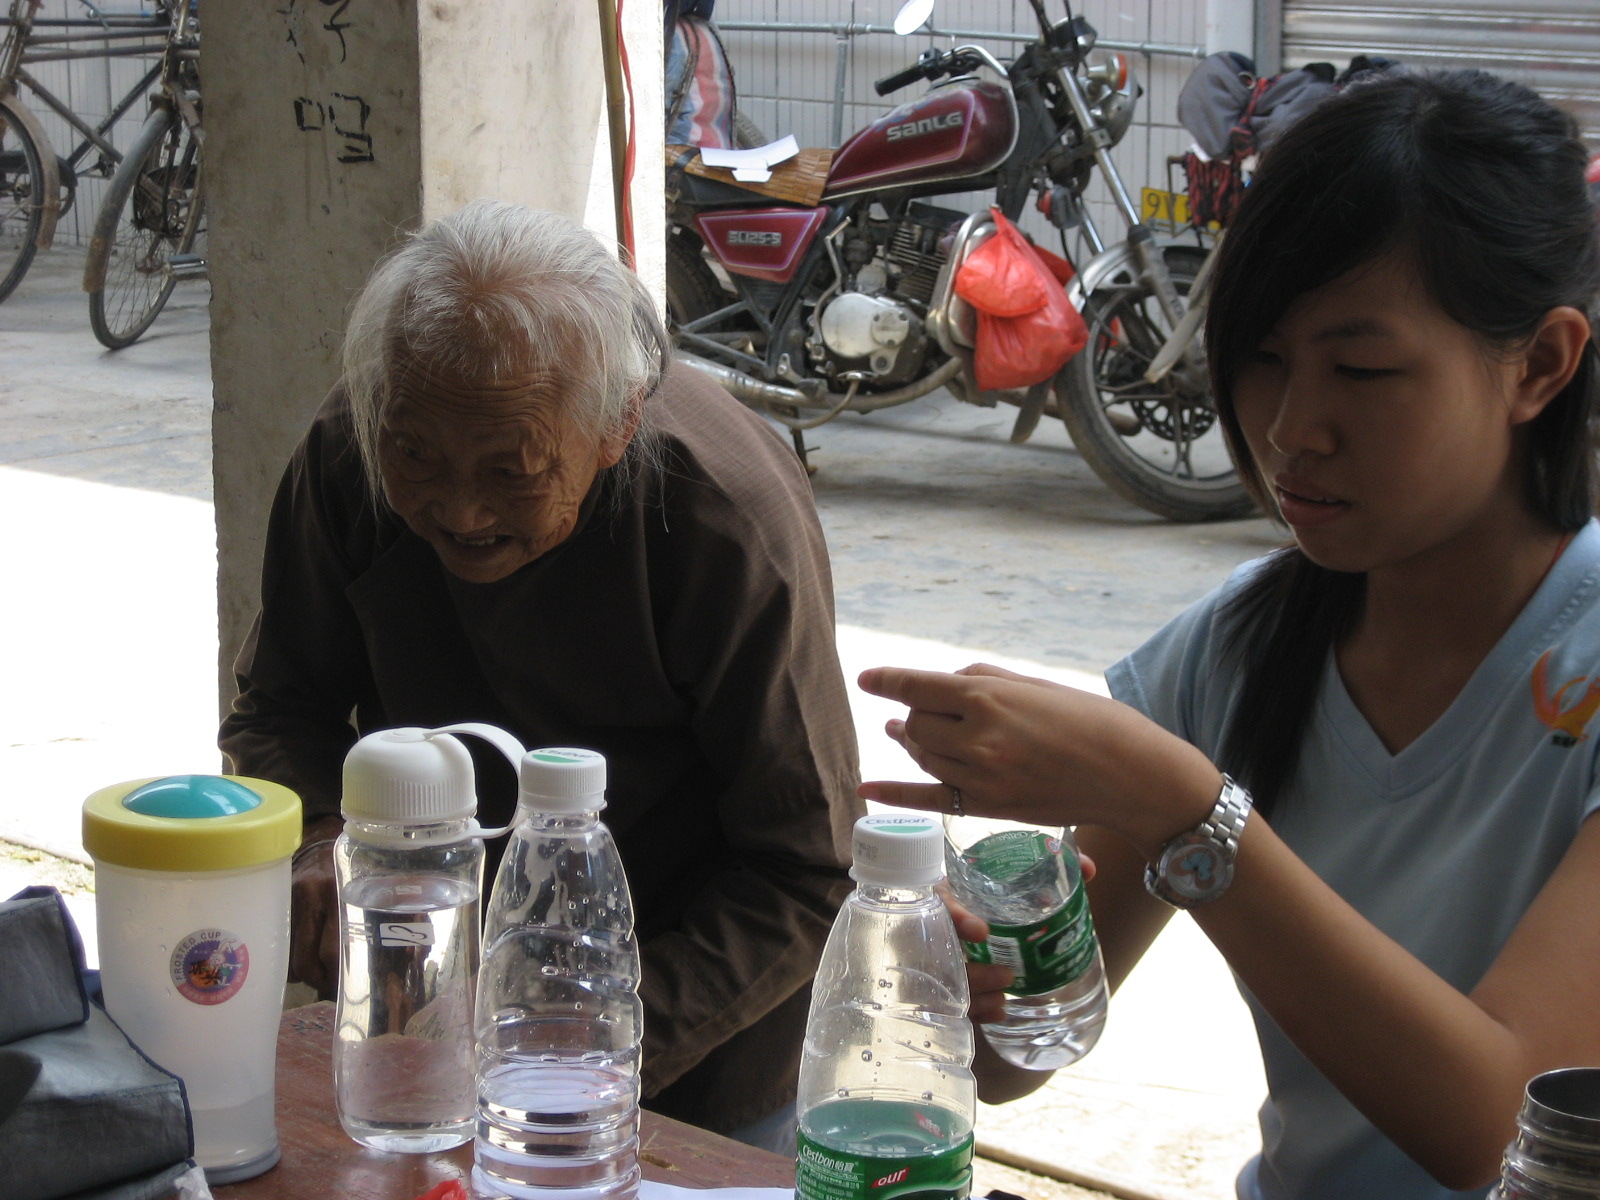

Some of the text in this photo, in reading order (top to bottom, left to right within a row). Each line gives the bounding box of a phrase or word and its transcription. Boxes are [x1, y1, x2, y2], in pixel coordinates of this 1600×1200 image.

[174, 931, 221, 981] FROSTED CUP
[877, 1168, 906, 1186] our
